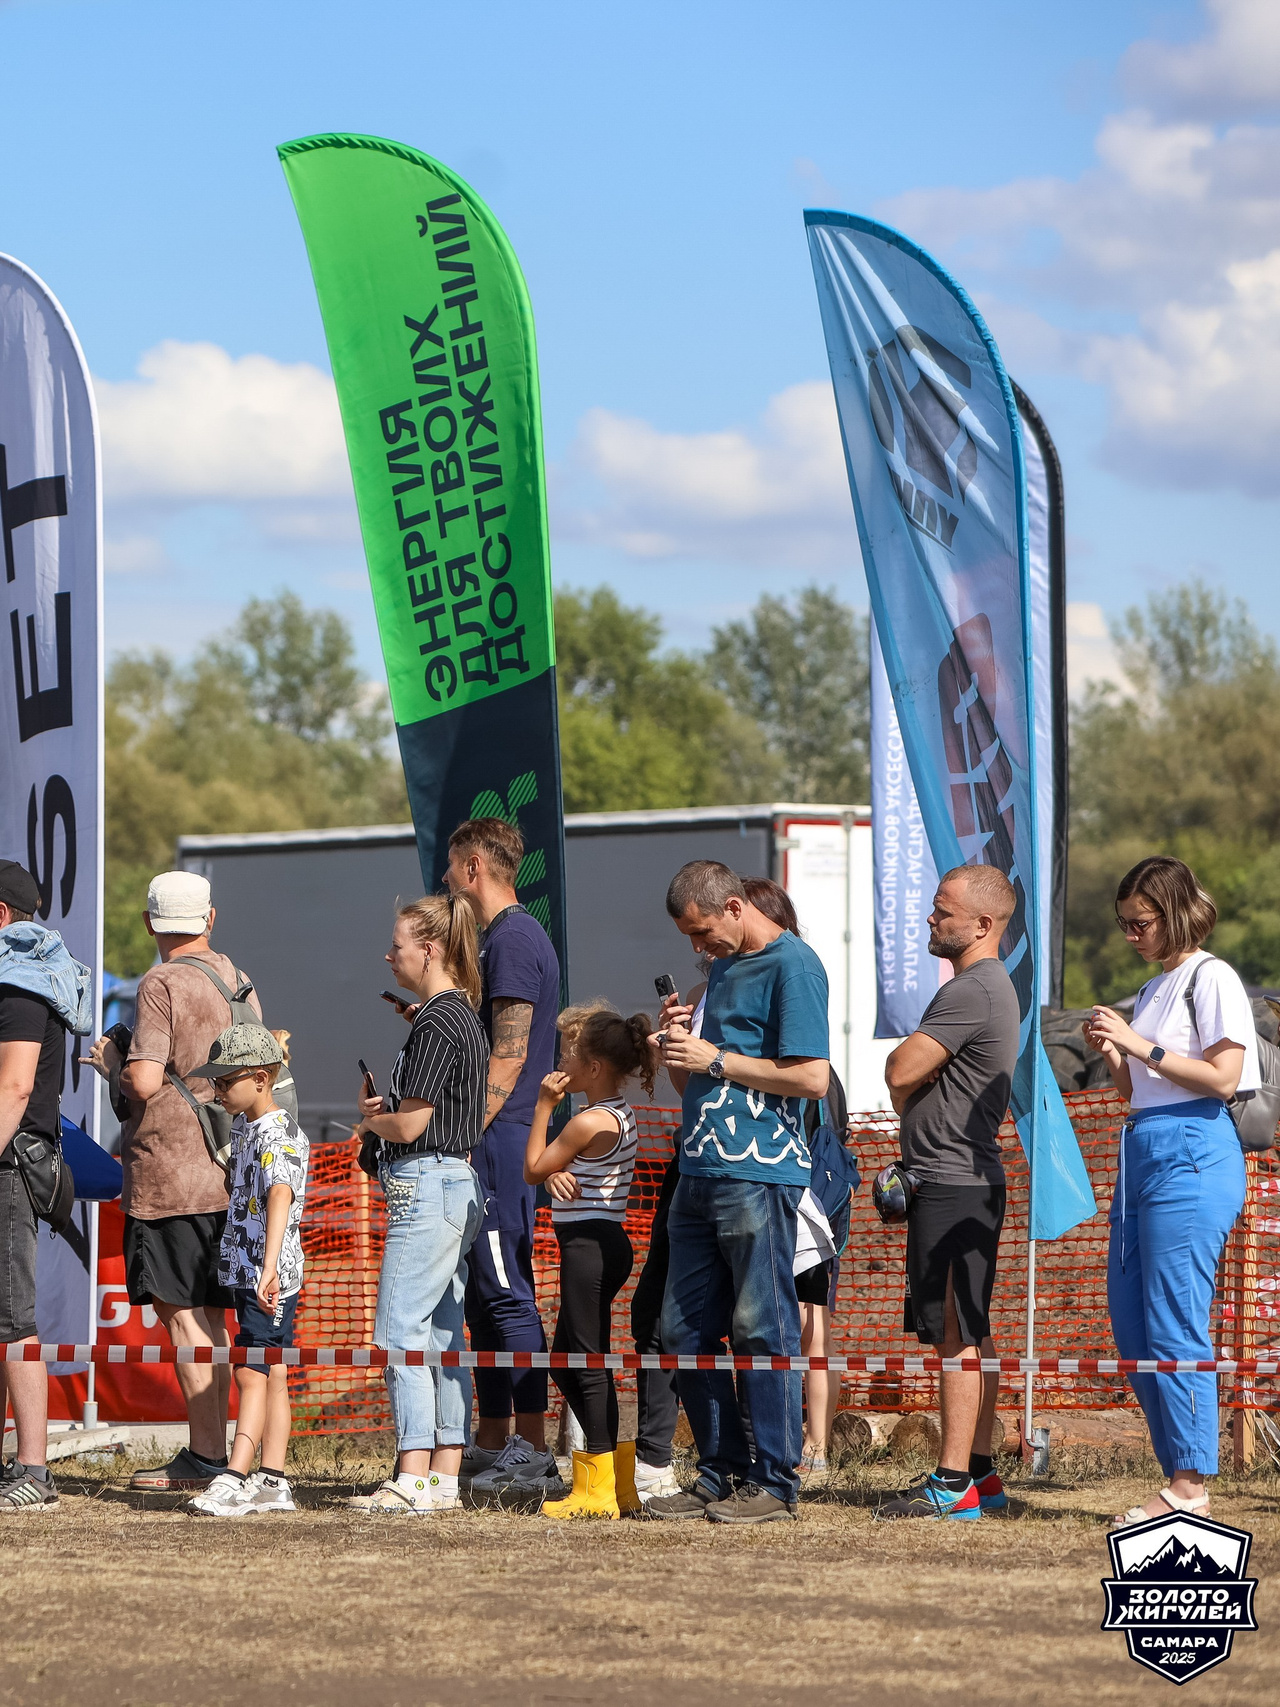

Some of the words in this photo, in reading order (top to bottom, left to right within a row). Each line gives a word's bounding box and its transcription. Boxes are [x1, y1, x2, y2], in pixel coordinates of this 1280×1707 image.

[379, 399, 458, 701] ЭНЕРГИЯ
[403, 303, 469, 539] ТВОИХ
[415, 193, 530, 674] ДОСТИЖЕНИЙ
[444, 552, 499, 686] ДЛЯ
